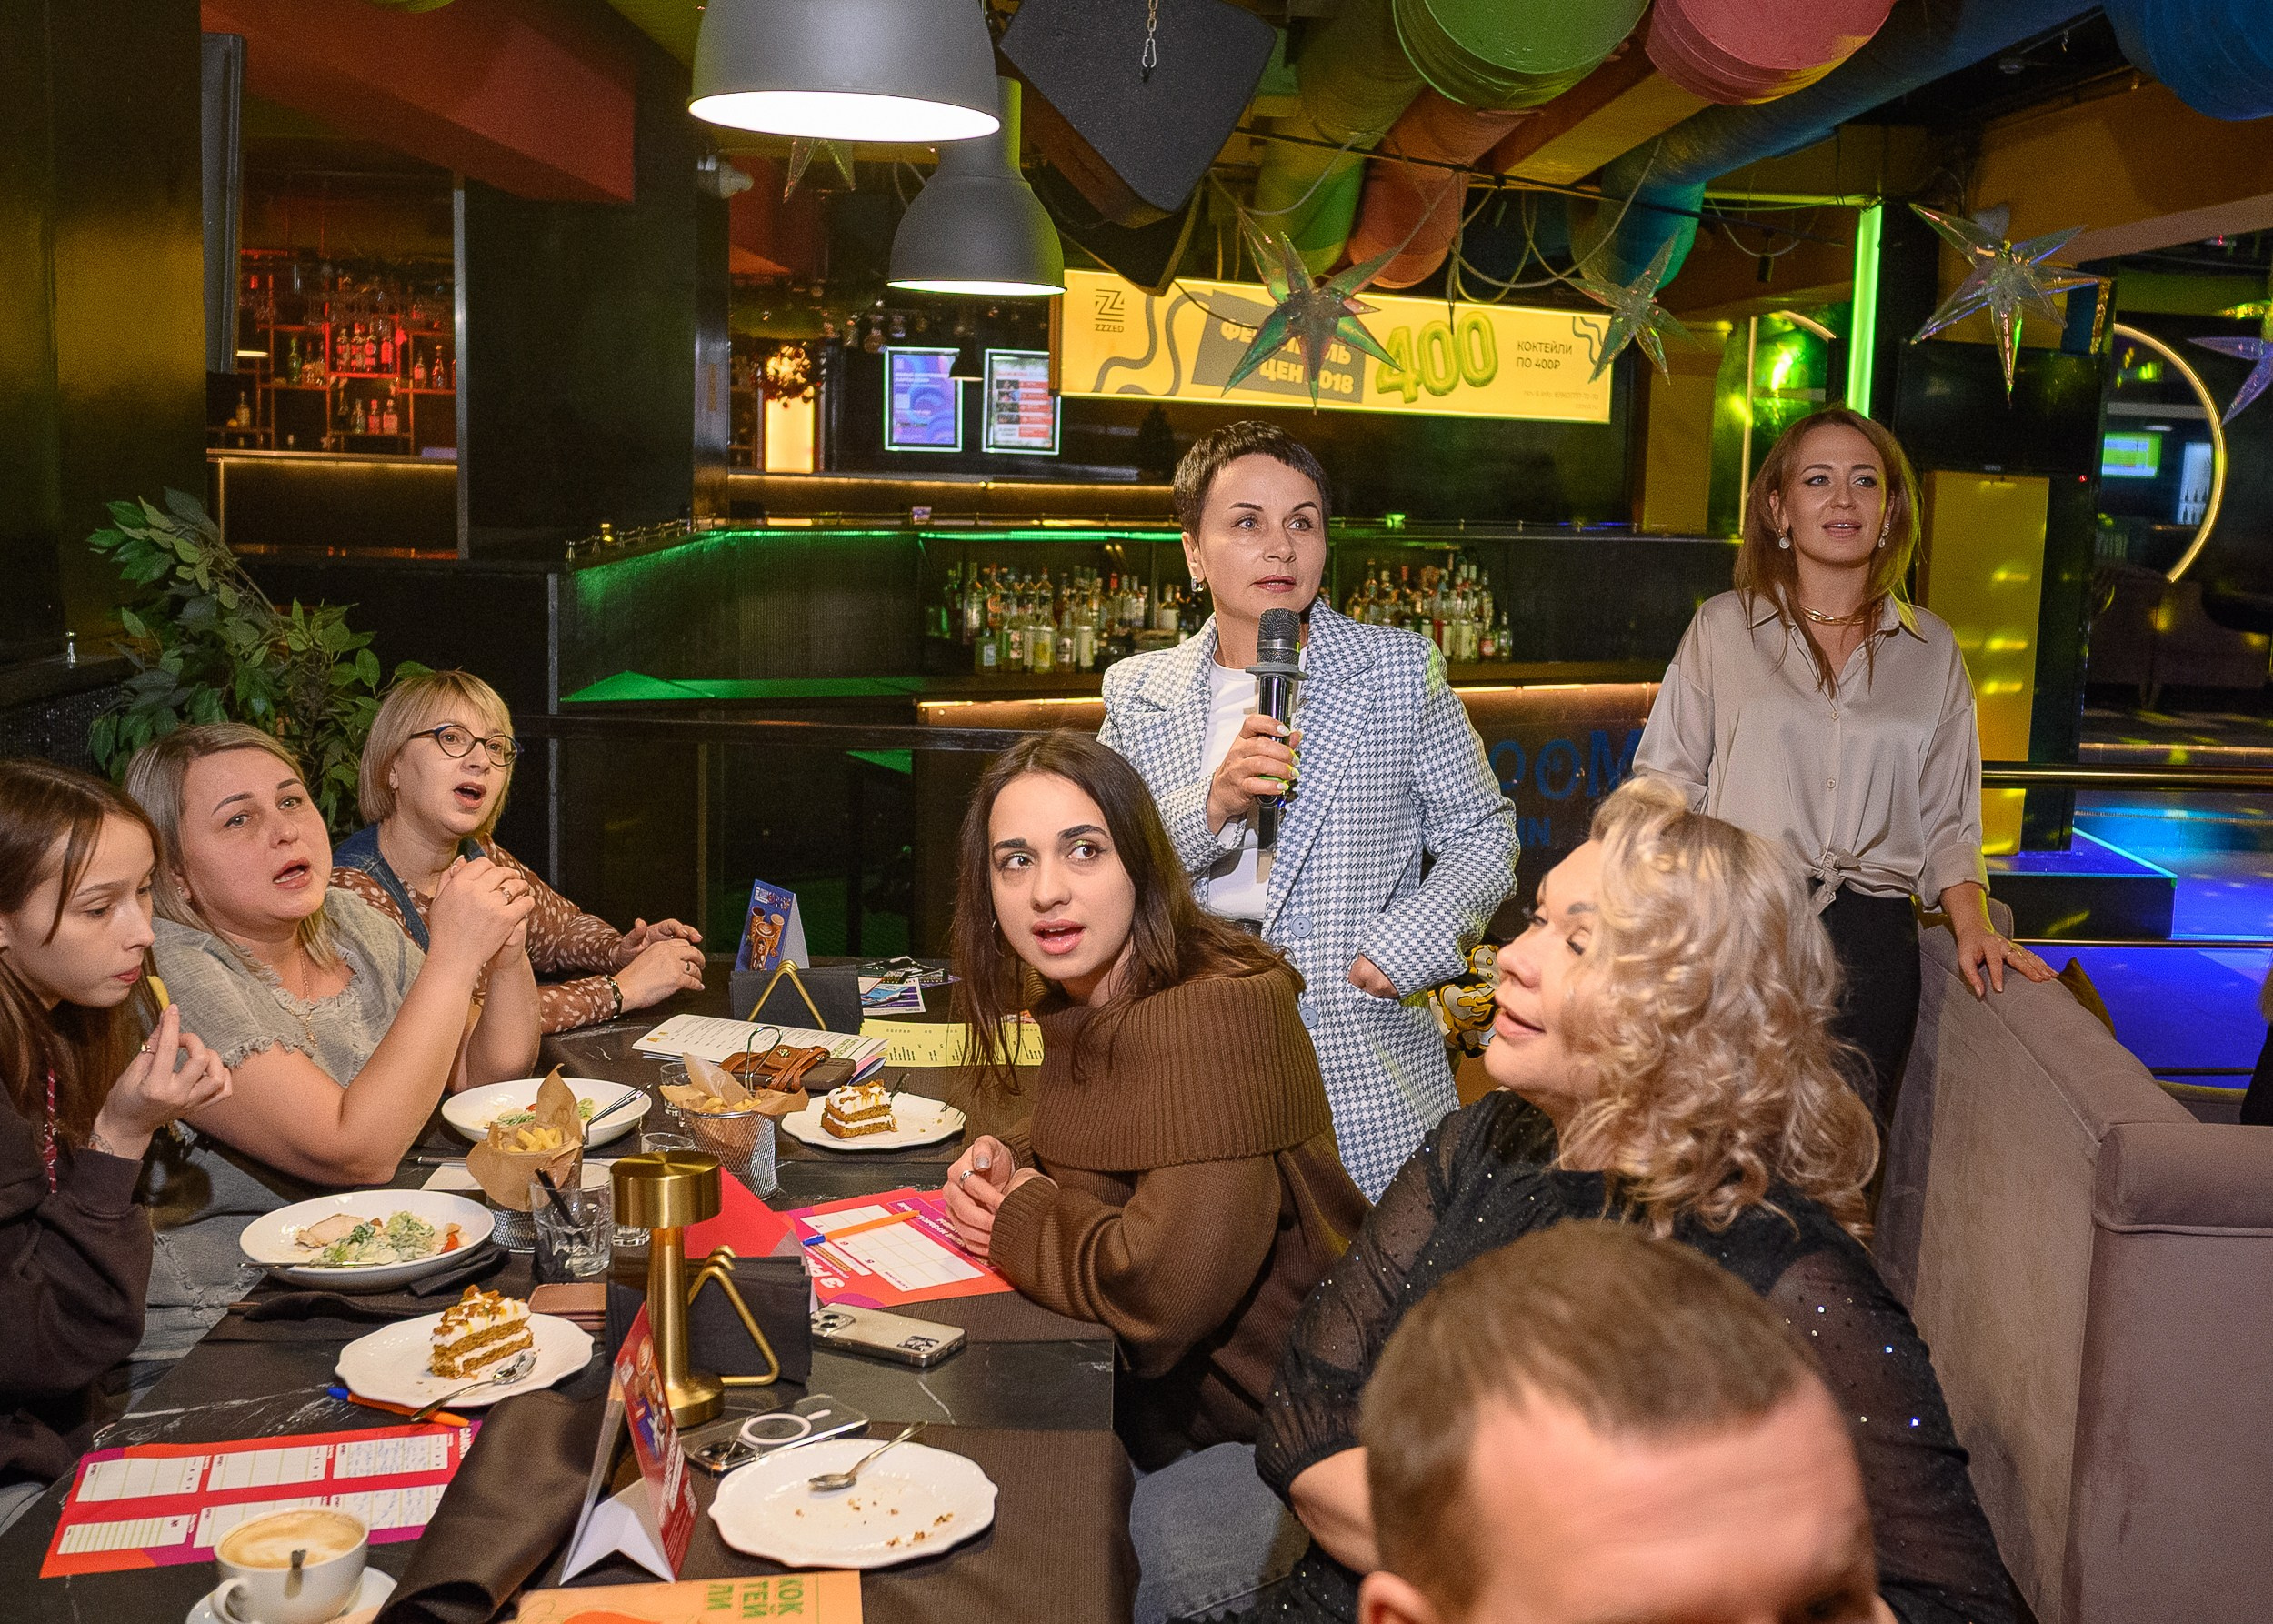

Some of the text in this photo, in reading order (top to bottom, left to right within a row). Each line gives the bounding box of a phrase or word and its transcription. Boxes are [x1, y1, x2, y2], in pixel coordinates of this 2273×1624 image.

[1095, 323, 1125, 333] ZZZED
[1375, 311, 1498, 404] 400
[1517, 340, 1573, 356] КОКТЕЙЛИ
[1517, 356, 1533, 369] ПО
[1259, 358, 1355, 395] ЦЕН 018
[1488, 729, 1645, 800] OOM
[706, 1584, 734, 1611] ЛИ
[742, 1580, 776, 1618] ТЕЙ
[778, 1578, 804, 1616] КОК
